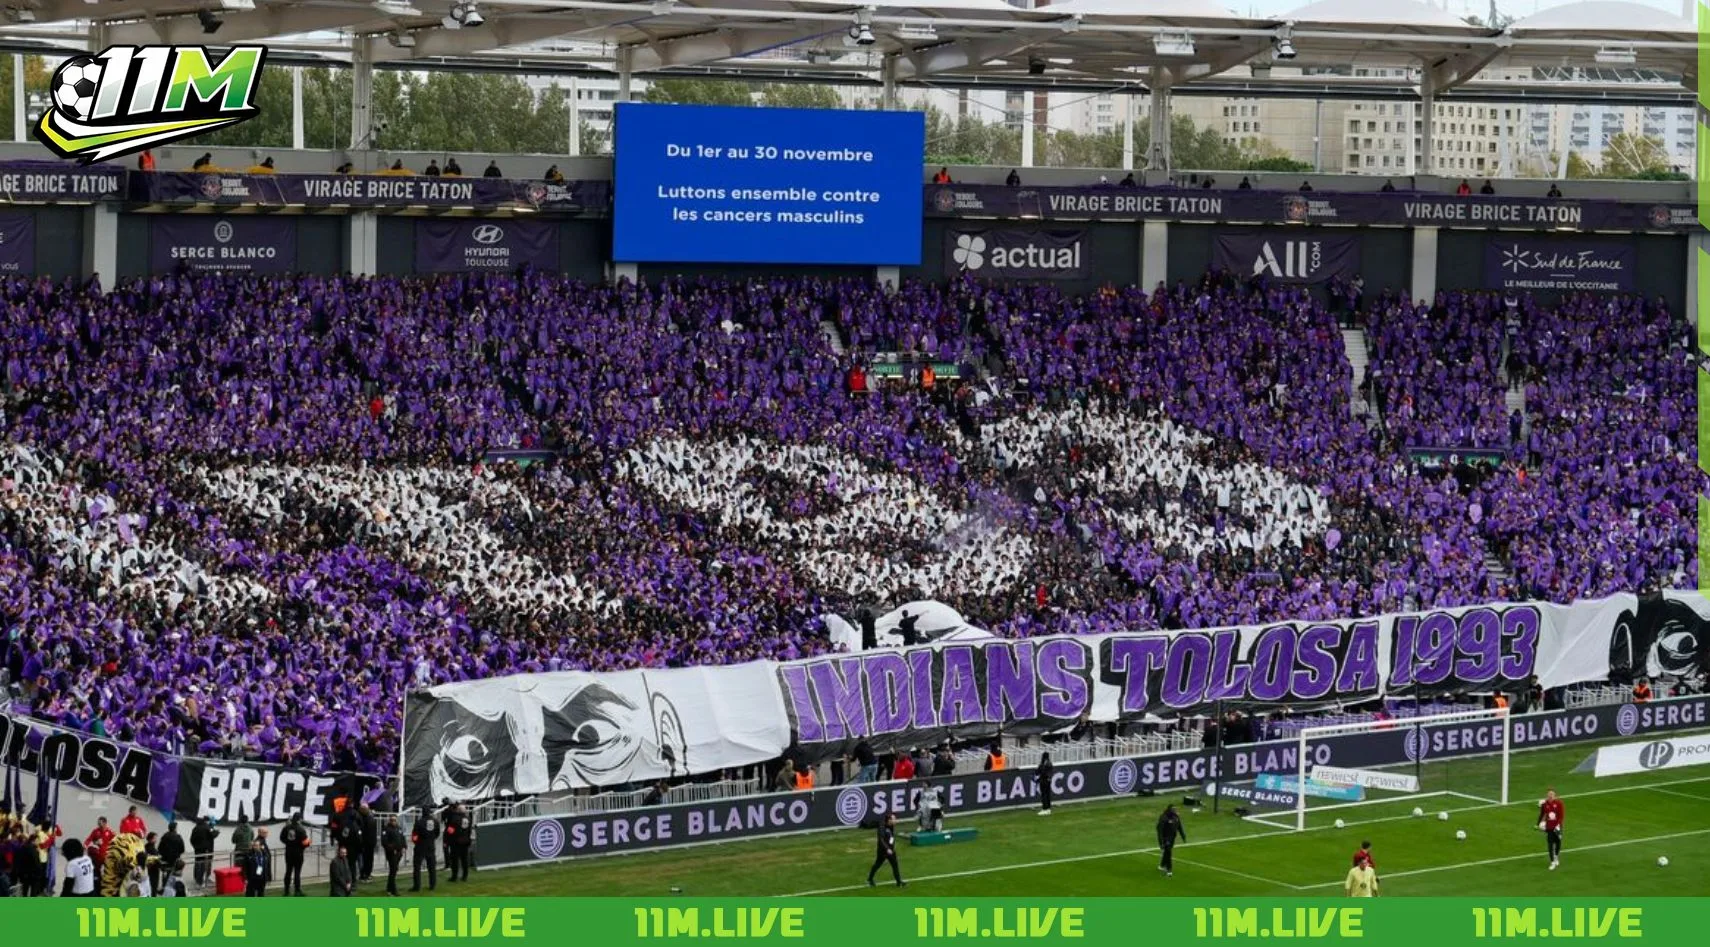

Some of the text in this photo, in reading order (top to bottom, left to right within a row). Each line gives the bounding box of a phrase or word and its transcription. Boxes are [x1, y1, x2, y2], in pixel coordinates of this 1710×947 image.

[666, 143, 874, 162] Du 1er au 30 novembre
[0, 174, 118, 194] GE BRICE TATON
[304, 179, 473, 200] VIRAGE BRICE TATON
[657, 185, 881, 202] Luttons ensemble contre
[1049, 194, 1222, 214] VIRAGE BRICE TATON
[1404, 202, 1582, 223] VIRAGE BRICE TATON
[672, 207, 864, 224] les cancers masculins
[171, 247, 276, 258] SERGE BLANCO
[465, 258, 510, 267] TOULOUSE
[991, 241, 1081, 269] actual
[1530, 250, 1623, 270] Sud de France
[1515, 280, 1556, 289] MEILLEUR
[1557, 281, 1568, 289] DE
[780, 605, 1541, 743] INDIANS TOLOSA 1993
[1641, 702, 1706, 728] SERGE
[1432, 713, 1598, 752] SERGE BLANCO
[0, 712, 151, 805] LOSA
[1141, 743, 1332, 785] SERGE BLANCO
[197, 766, 335, 826] BRICE
[1220, 786, 1294, 805] SERGE BLANCO
[570, 800, 809, 850] SERGE BLANCO
